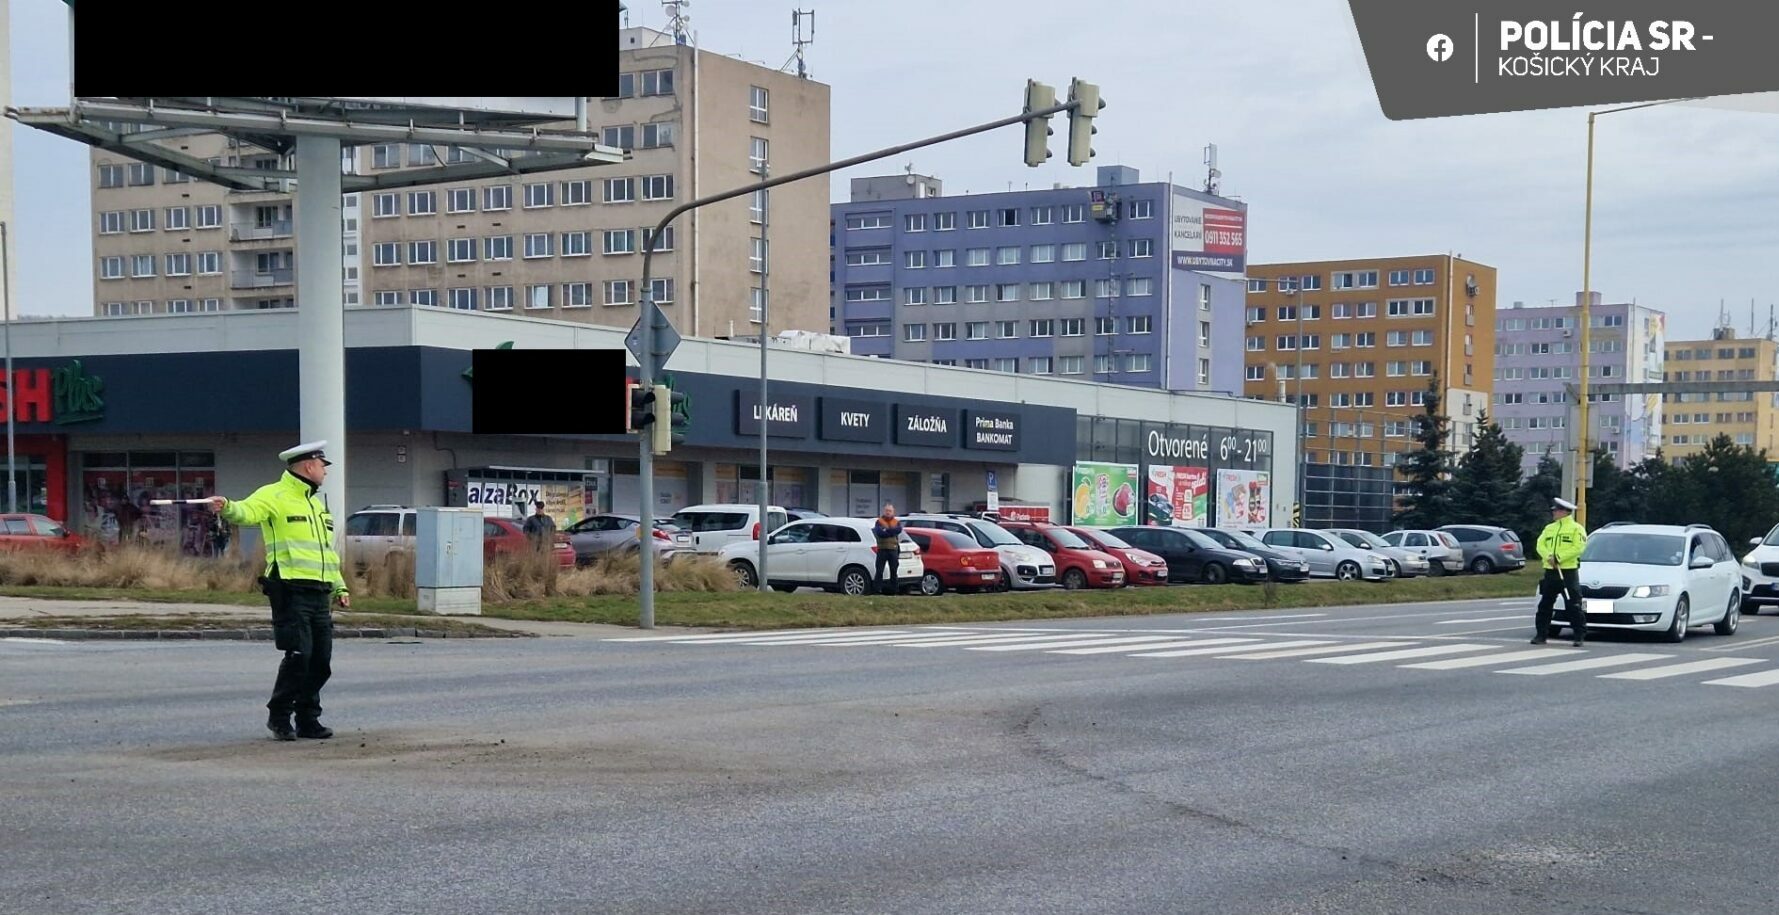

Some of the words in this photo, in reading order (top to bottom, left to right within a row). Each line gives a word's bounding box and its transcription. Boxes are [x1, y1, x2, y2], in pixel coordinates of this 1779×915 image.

[1204, 230, 1219, 244] 0911
[1219, 231, 1231, 245] 352
[1231, 232, 1243, 246] 565
[753, 403, 798, 422] LKÁREŇ
[840, 411, 870, 428] KVETY
[907, 414, 947, 433] ZÁLOŽŇA
[975, 416, 994, 429] Prima
[995, 418, 1014, 430] Banka
[976, 432, 1013, 445] BANKOMAT
[1148, 430, 1208, 459] Otvorené
[468, 483, 539, 504] alzaBox
